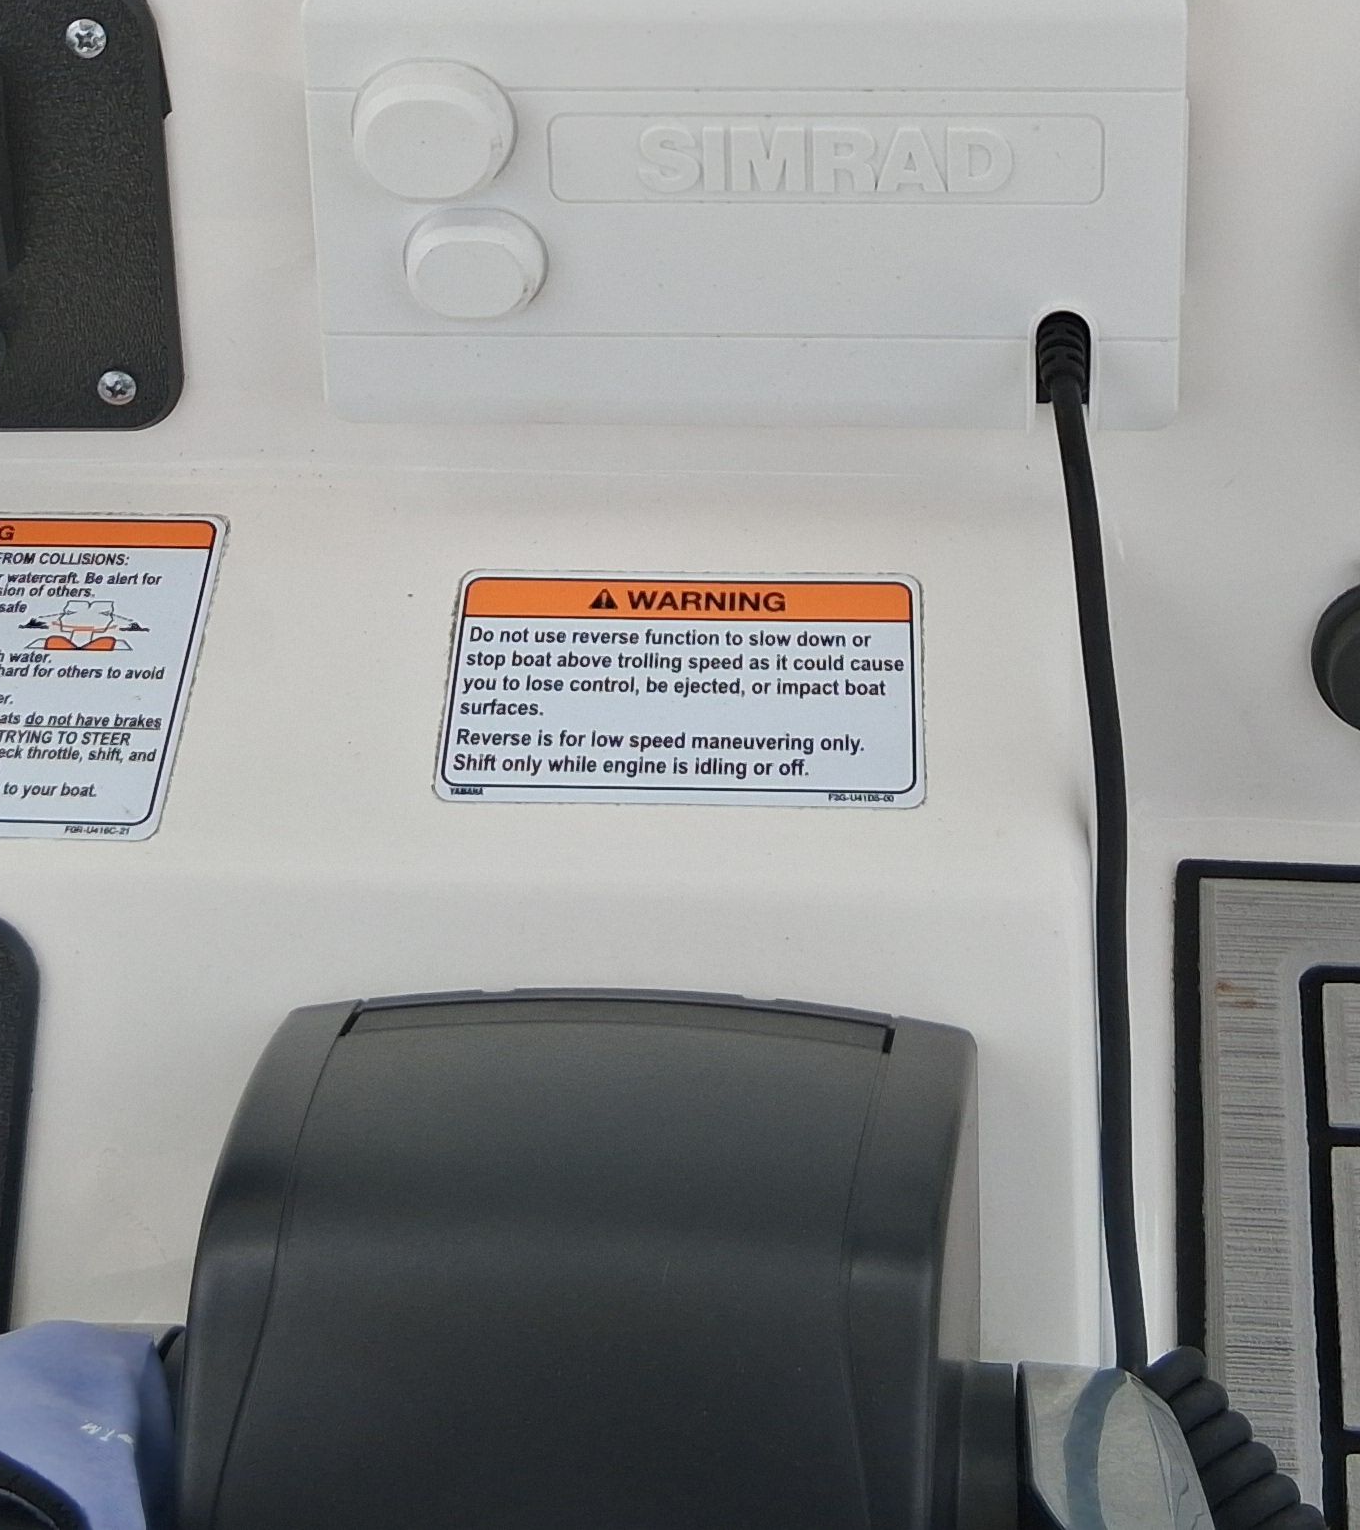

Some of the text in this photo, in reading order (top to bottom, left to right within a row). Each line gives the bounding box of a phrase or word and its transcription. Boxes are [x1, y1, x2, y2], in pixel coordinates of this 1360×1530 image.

[638, 125, 1014, 195] SIMRAD
[38, 551, 130, 565] COLLISIONS:
[6, 570, 79, 583] watercraft.
[84, 571, 103, 584] Be
[107, 571, 138, 584] alert
[141, 572, 161, 585] for
[29, 583, 44, 596] of
[46, 584, 94, 597] others.
[626, 590, 787, 613] WARNING
[469, 624, 871, 647] Do not use reverse function to slow down or
[465, 649, 904, 673] stop boat above trolling speed as it could cause
[462, 673, 886, 699] you to lose control, be ejected, or impact boat
[459, 697, 543, 715] surfaces.
[456, 727, 864, 755] Reverse is for low speed maneuvering only.
[452, 752, 809, 779] Shift only while engine is idling or off.
